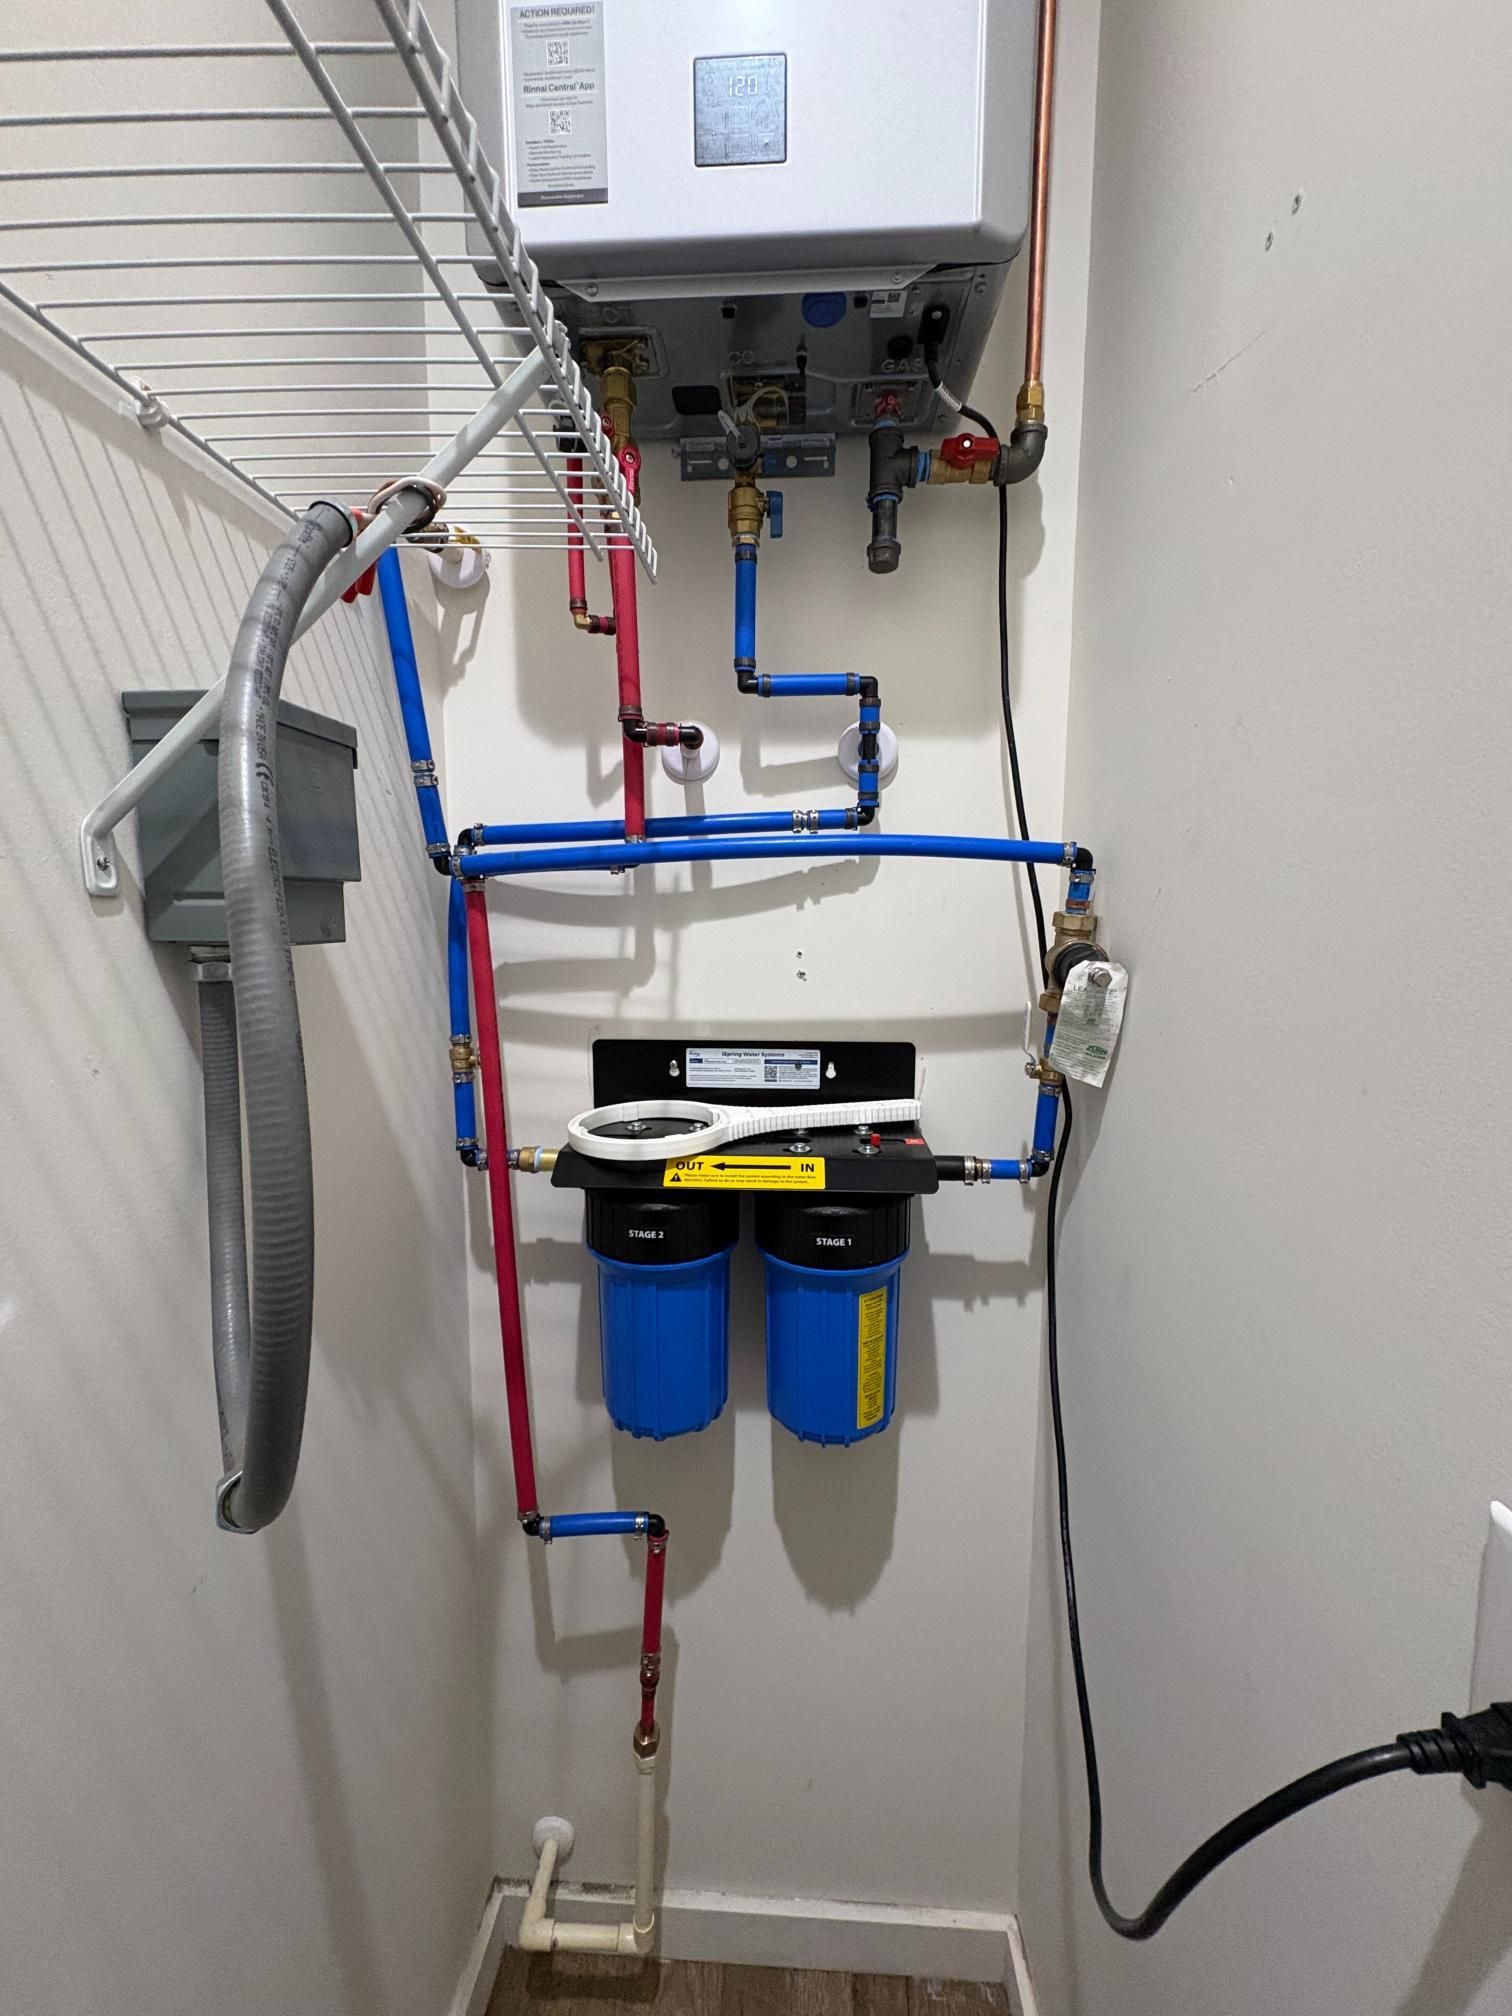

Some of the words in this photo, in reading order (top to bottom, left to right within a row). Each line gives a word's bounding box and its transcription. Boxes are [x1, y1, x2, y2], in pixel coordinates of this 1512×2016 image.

[520, 8, 549, 18] ACTION
[550, 5, 595, 16] REQUIRED!
[523, 82, 547, 94] Rinnai
[548, 82, 576, 92] Central
[580, 81, 595, 91] App
[729, 74, 758, 97] 120
[676, 1162, 704, 1171] OUT
[800, 1163, 815, 1173] IN
[628, 1230, 656, 1238] STAGE
[816, 1237, 845, 1246] STAGE
[846, 1238, 852, 1246] 1
